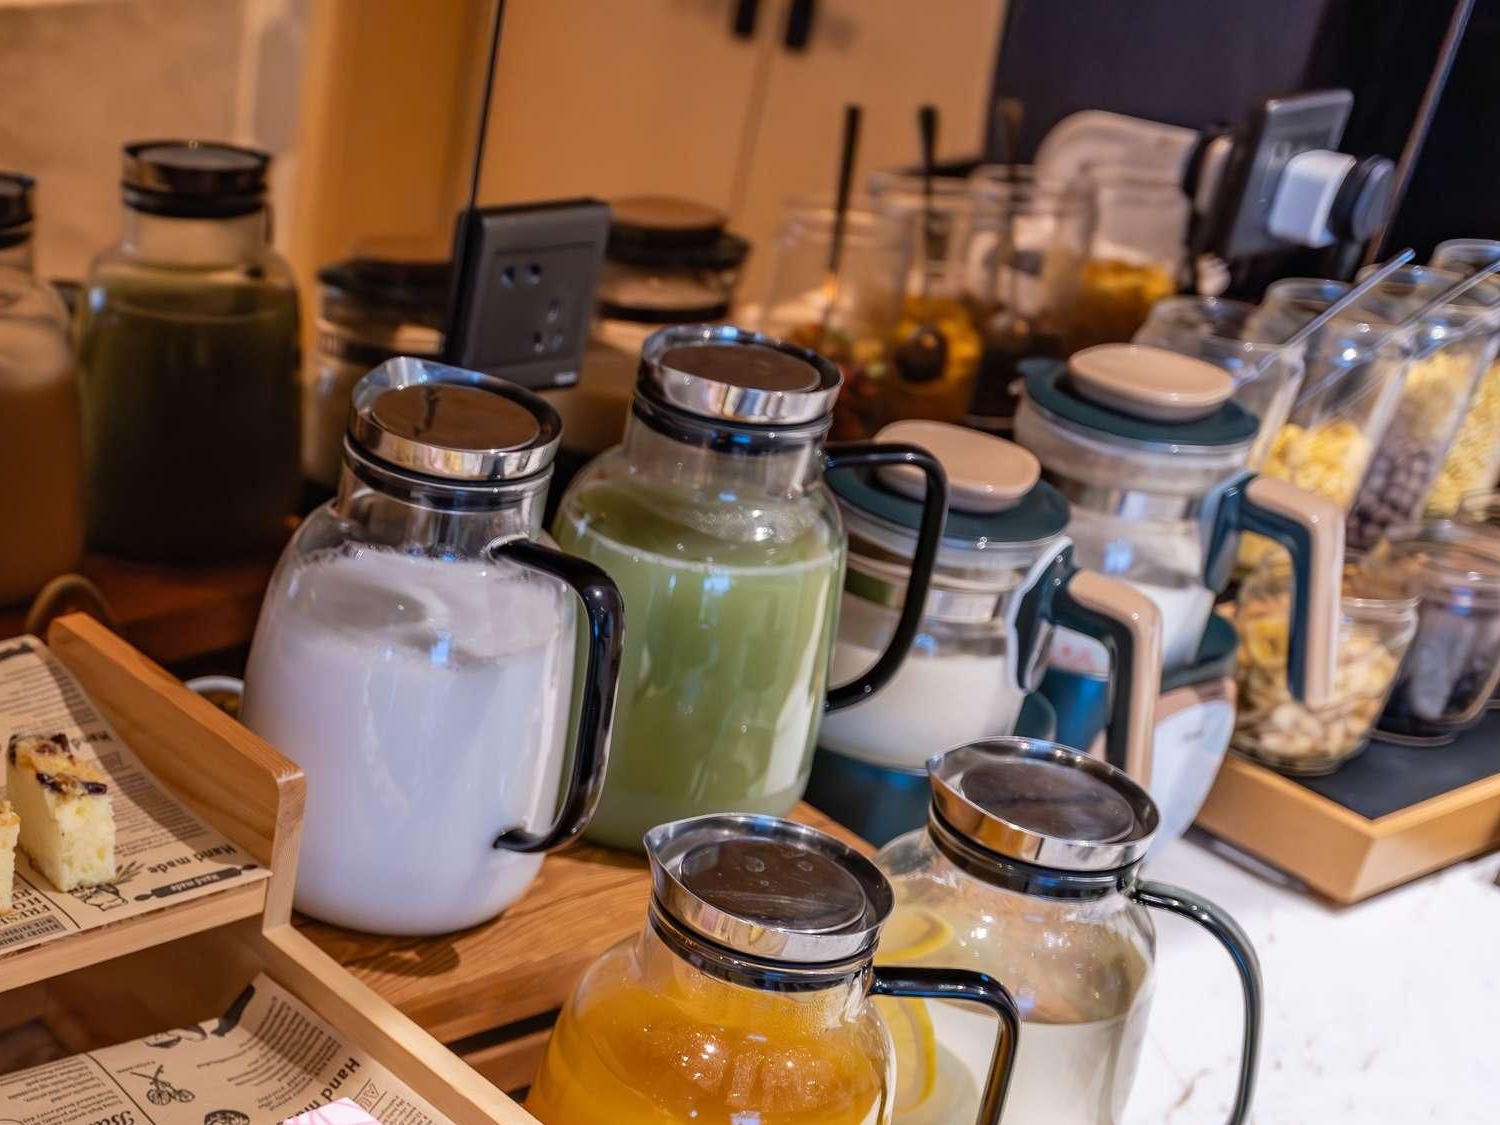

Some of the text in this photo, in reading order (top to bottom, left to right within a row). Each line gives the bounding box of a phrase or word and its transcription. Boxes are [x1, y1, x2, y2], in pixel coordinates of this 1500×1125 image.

[147, 845, 236, 875] Hand made
[321, 1058, 360, 1103] Hand
